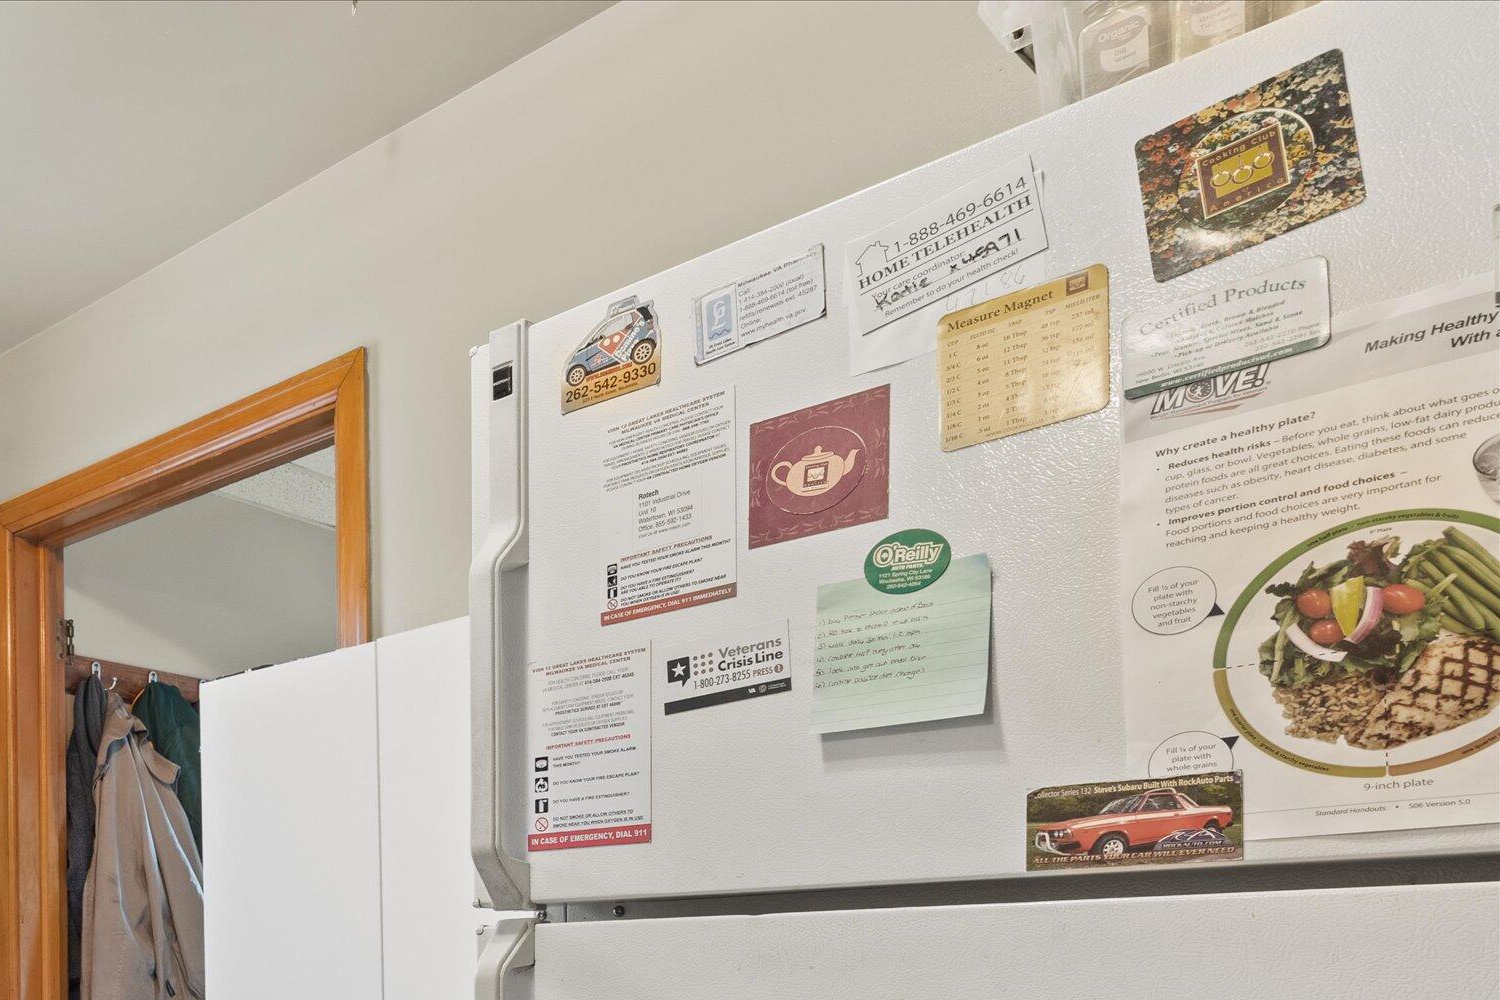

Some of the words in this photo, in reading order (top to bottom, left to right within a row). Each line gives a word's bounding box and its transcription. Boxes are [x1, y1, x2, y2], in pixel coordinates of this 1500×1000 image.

[1099, 20, 1140, 42] Organic
[1202, 144, 1246, 166] Cooking
[1251, 131, 1276, 144] Club
[894, 176, 1028, 252] 1-888-469-6614
[859, 260, 910, 290] HOME
[912, 195, 1031, 264] TELEHEALTH
[884, 294, 925, 318] Remember
[967, 260, 991, 278] health
[947, 308, 1000, 332] Measure
[1004, 290, 1053, 314] Magnet
[1140, 295, 1217, 336] Certified
[1225, 279, 1306, 302] Products
[1364, 329, 1426, 353] Making
[1431, 311, 1499, 335] Healthy
[1451, 330, 1490, 348] With
[566, 363, 656, 403] 262-542-9330
[1156, 448, 1180, 458] Why
[1183, 437, 1218, 451] create
[1230, 422, 1275, 439] healthy
[1278, 412, 1316, 428] plate?
[1168, 455, 1209, 469] Reduces
[1211, 446, 1244, 460] health
[1247, 439, 1271, 452] risks
[1282, 430, 1315, 443] Before
[1318, 424, 1337, 436] you
[1340, 420, 1359, 429] eat,
[1362, 412, 1389, 423] think
[1392, 405, 1425, 418] about
[1428, 397, 1457, 408] what
[1461, 390, 1489, 402] goes
[1165, 472, 1184, 482] cup,
[1187, 466, 1211, 478] glass,
[1228, 456, 1254, 468] bowl.
[1257, 441, 1315, 460] Vegetables,
[1318, 434, 1350, 447] whole
[1353, 426, 1388, 439] grains,
[1391, 416, 1430, 429] low-fat
[1434, 410, 1462, 420] dairy
[1165, 480, 1199, 493] protein
[1202, 473, 1228, 484] foods
[1262, 460, 1288, 472] great
[1290, 450, 1332, 464] choices.
[1335, 442, 1368, 454] Eating
[1371, 434, 1401, 445] these
[1404, 427, 1436, 438] foods
[1439, 422, 1459, 431] can
[1462, 413, 1499, 426] reduce
[1165, 489, 1204, 503] diseases
[1206, 484, 1228, 495] such
[1243, 472, 1282, 485] obesity,
[1285, 466, 1312, 477] heart
[1314, 458, 1355, 470] disease,
[1358, 446, 1407, 460] diabetes,
[1411, 440, 1432, 449] and
[1435, 432, 1467, 443] some
[638, 490, 659, 500] Rotech
[677, 490, 691, 498] Drive
[1165, 503, 1190, 515] types
[1204, 493, 1239, 505] cancer.
[1169, 510, 1215, 525] Improves
[1218, 501, 1256, 516] portion
[1259, 492, 1297, 506] control
[1300, 486, 1321, 497] and
[1323, 481, 1349, 492] food
[1352, 472, 1395, 486] choices
[1166, 526, 1190, 537] Food
[1192, 518, 1232, 534] portions
[1234, 514, 1252, 522] and
[1255, 508, 1278, 518] food
[1280, 499, 1320, 513] choices
[1341, 489, 1363, 500] very
[1366, 479, 1422, 495] important
[1425, 474, 1441, 483] for
[1166, 534, 1206, 548] reaching
[1209, 531, 1227, 539] and
[1230, 521, 1269, 535] keeping
[1280, 511, 1319, 525] healthy
[1322, 504, 1361, 517] weight.
[874, 542, 943, 567] O'Reilly
[1180, 580, 1198, 588] your
[633, 603, 666, 614] EMERGENCY,
[693, 588, 732, 601] IMMEDIATELY
[1150, 598, 1197, 610] non-starchy
[1154, 592, 1174, 602] plate
[1176, 589, 1193, 597] with
[1152, 608, 1196, 619] vegetables
[1175, 617, 1191, 625] fruit
[718, 638, 782, 658] Veterans
[718, 657, 753, 671] Crisis
[755, 651, 783, 663] Line
[694, 670, 750, 689] 1-800-273-8255
[753, 666, 773, 677] PRESS
[546, 742, 574, 750] IMPORTANT
[595, 734, 631, 743] PRECAUTIONS
[1198, 743, 1217, 752] your
[1167, 764, 1190, 772] whole
[1193, 761, 1217, 770] grains
[1172, 754, 1191, 763] plate
[1061, 789, 1079, 797] Series
[1081, 787, 1091, 795] 132
[1094, 785, 1116, 794] Steve's
[1118, 783, 1142, 791] Subaru
[1143, 780, 1159, 789] Built
[1179, 777, 1213, 785] RockAuto
[1364, 780, 1399, 791] 9-inch
[1404, 778, 1434, 789] plate
[1315, 808, 1348, 817] Standard
[1350, 806, 1386, 814] Handouts
[1426, 800, 1456, 808] Version
[570, 832, 614, 842] EMERGENCY,
[1162, 839, 1223, 848] ROCKAUTO.COM
[1104, 852, 1133, 860] YOUR
[1154, 849, 1177, 857] WILL
[1178, 848, 1207, 856] EVER
[1208, 847, 1236, 855] NEED
